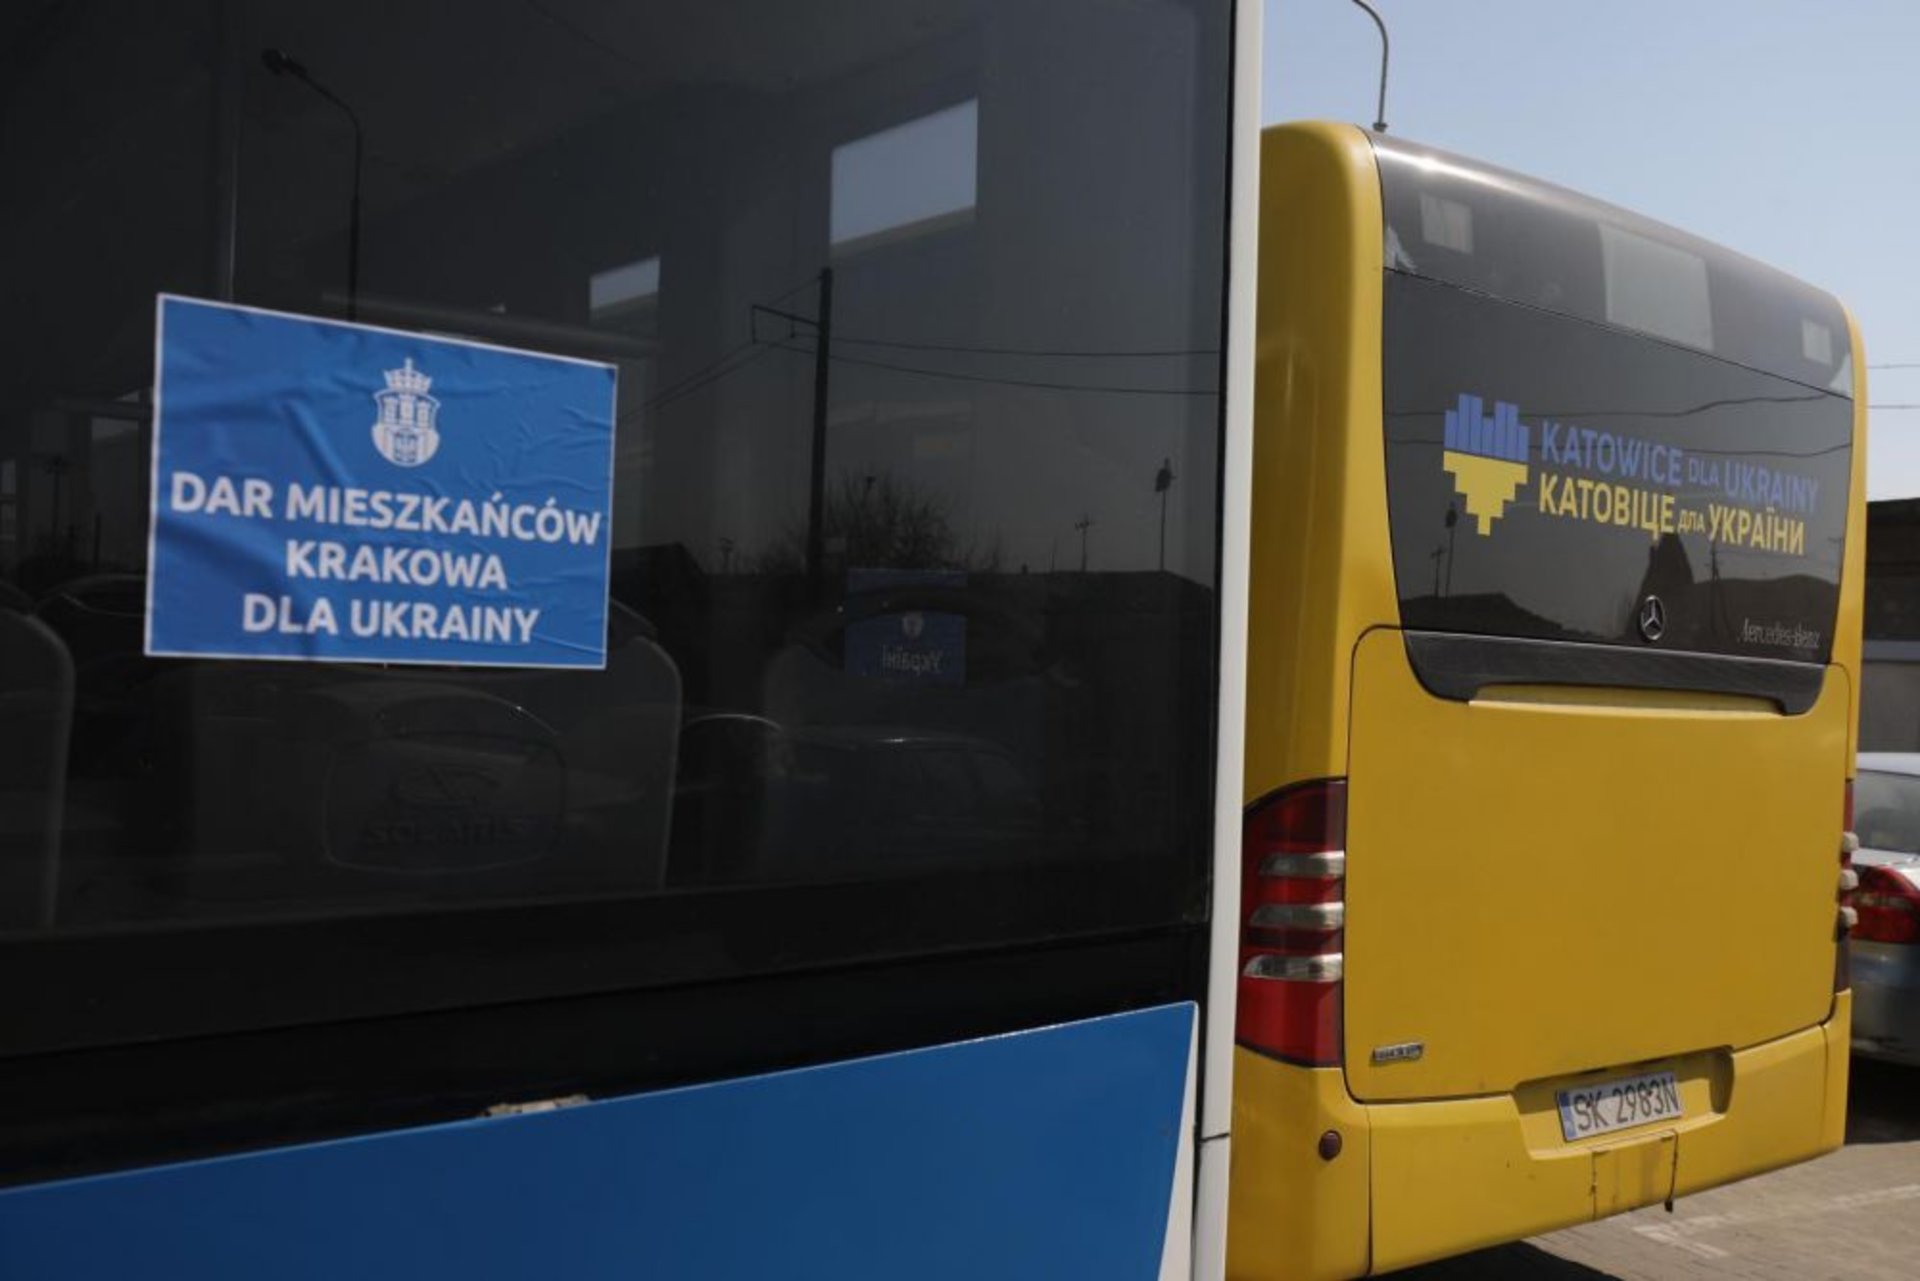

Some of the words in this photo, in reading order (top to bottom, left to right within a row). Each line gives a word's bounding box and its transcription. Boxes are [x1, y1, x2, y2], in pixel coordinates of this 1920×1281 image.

[1541, 419, 1684, 488] KATOWICE
[1688, 458, 1720, 488] DLA
[1724, 461, 1820, 512] UKRAINY
[171, 472, 273, 519] DAR
[285, 483, 602, 545] MIESZKAŃCÓW
[1538, 473, 1676, 541] КАТОВІЦЕ
[1708, 503, 1806, 556] УКРАЇНИ
[285, 539, 508, 591] KRAKOWA
[242, 593, 339, 636] DLA
[350, 600, 541, 644] UKRAINY
[1573, 1088, 1609, 1131] SK
[1611, 1076, 1680, 1124] 2983N
